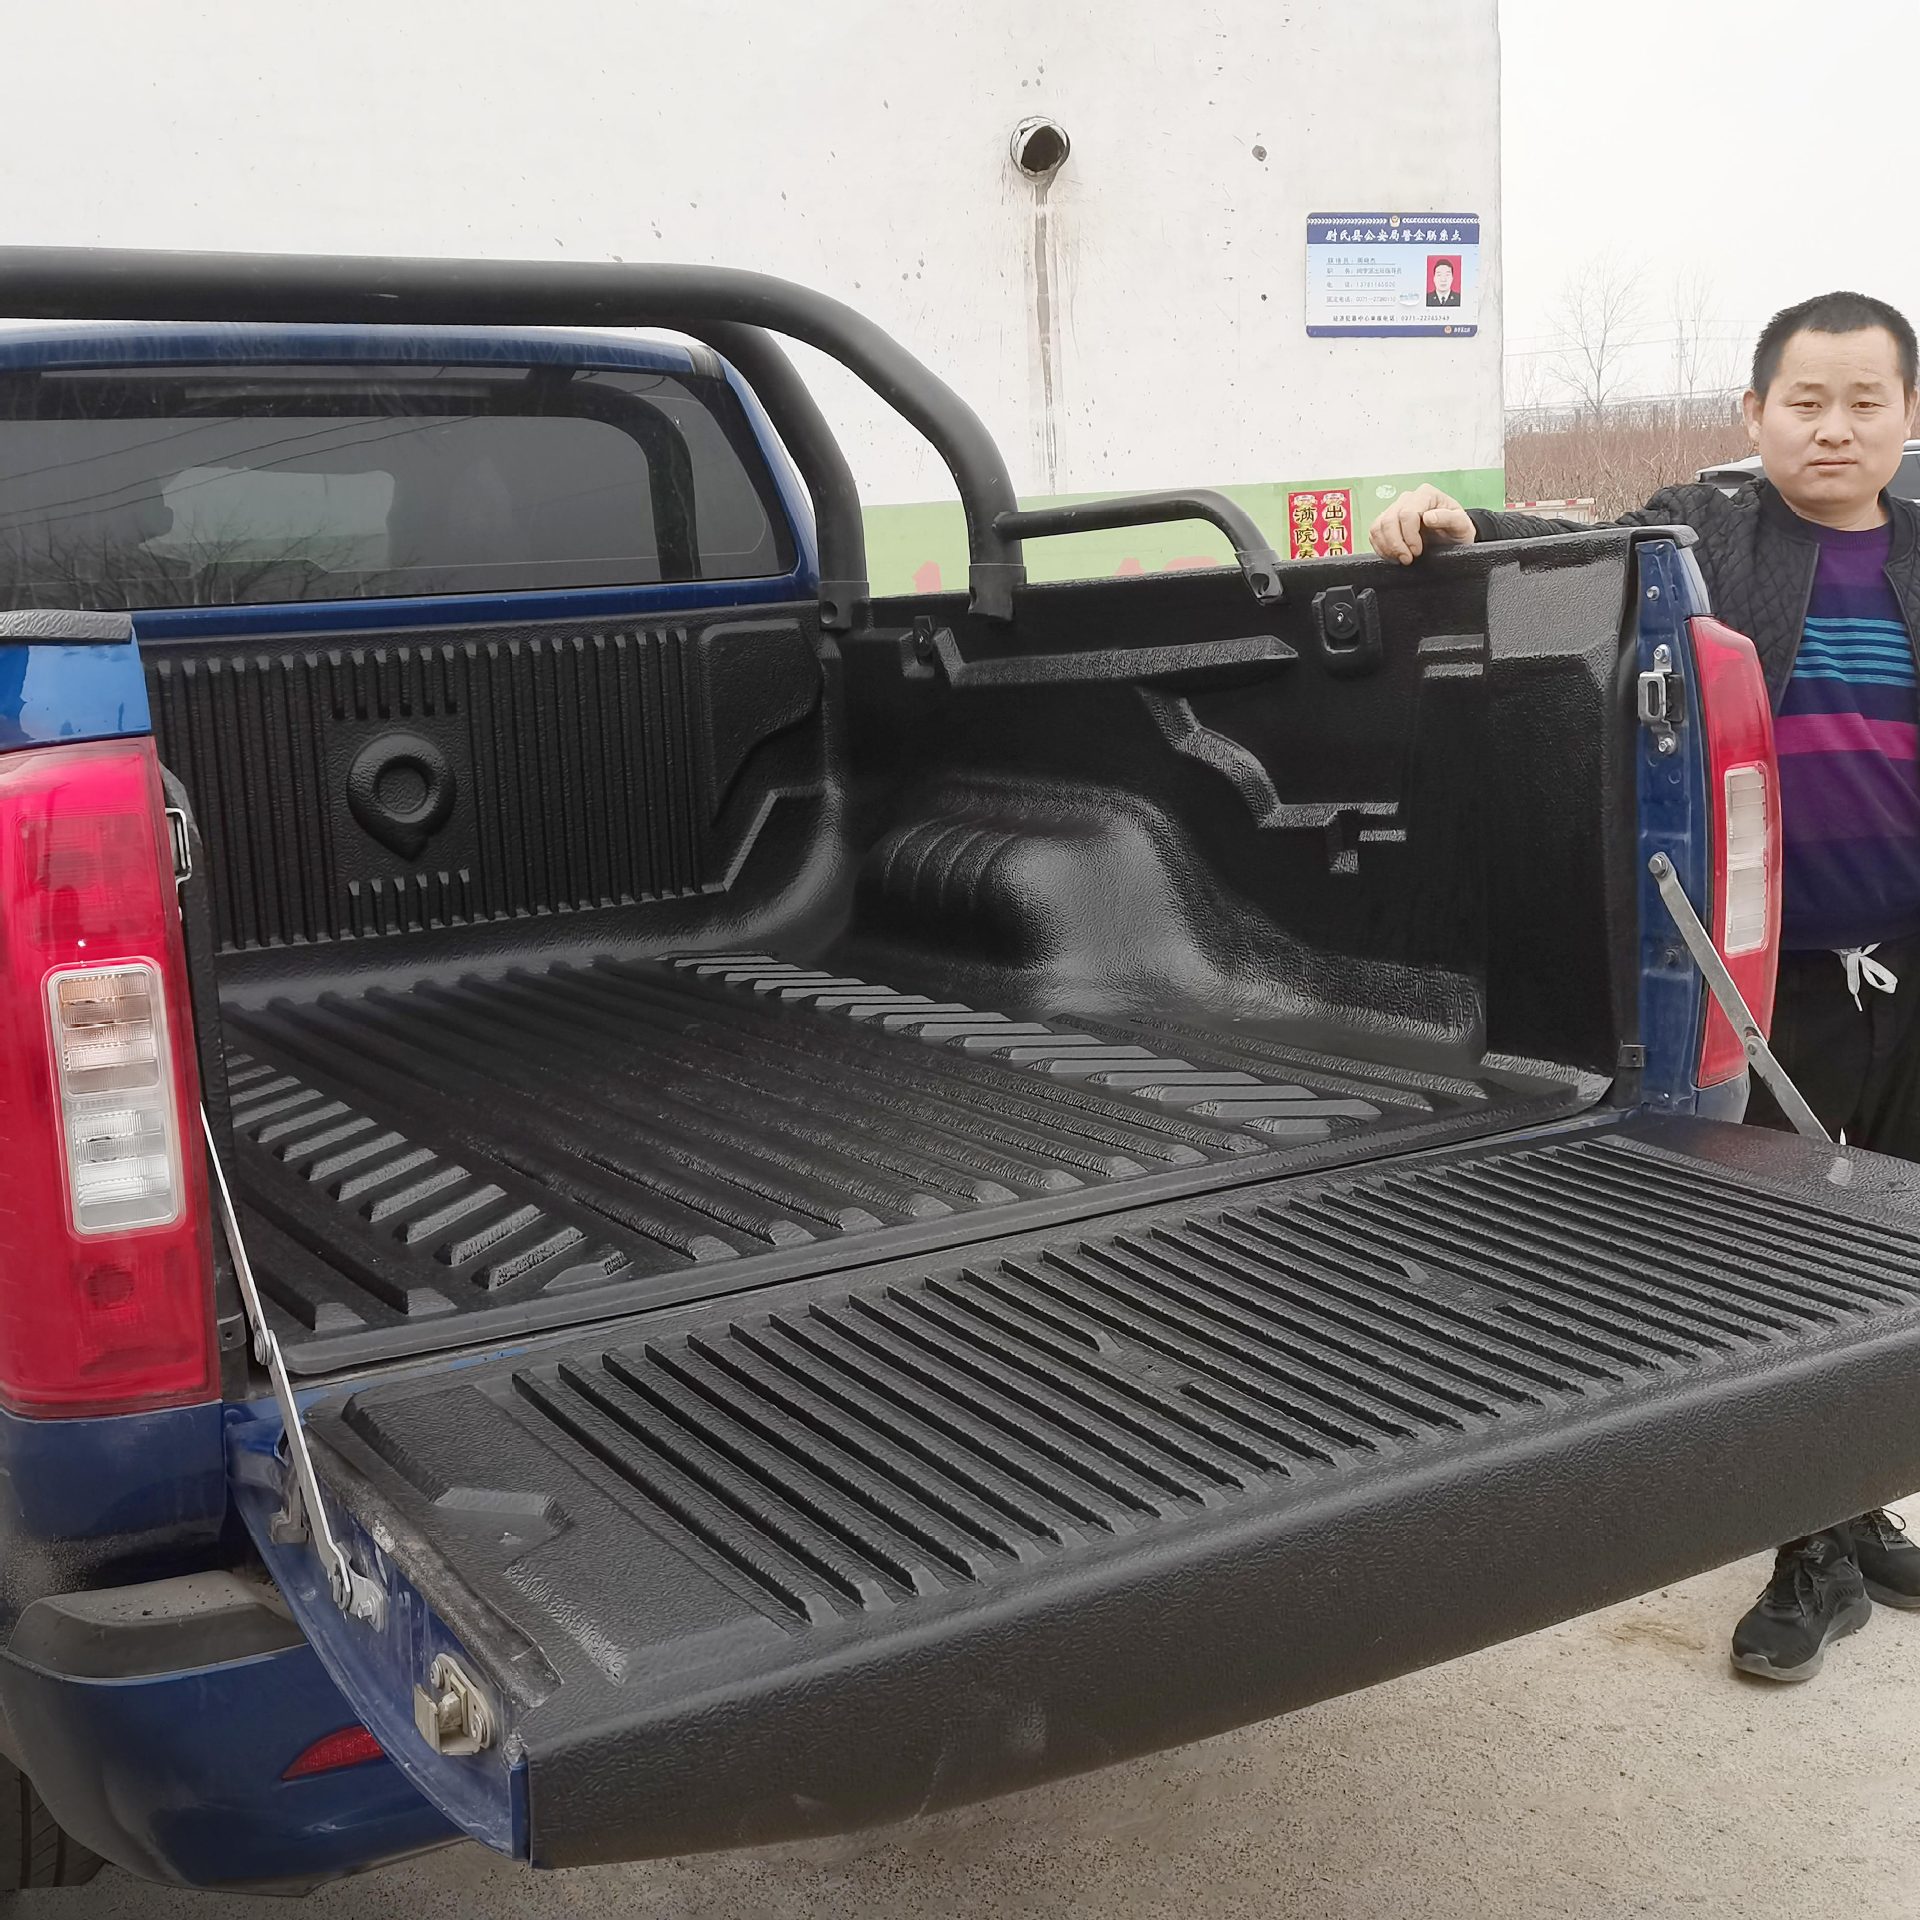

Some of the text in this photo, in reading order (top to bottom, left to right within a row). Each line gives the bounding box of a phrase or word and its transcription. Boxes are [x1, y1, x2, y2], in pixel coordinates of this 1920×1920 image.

[1325, 229, 1462, 242] 尉氏县公安局警企联系点
